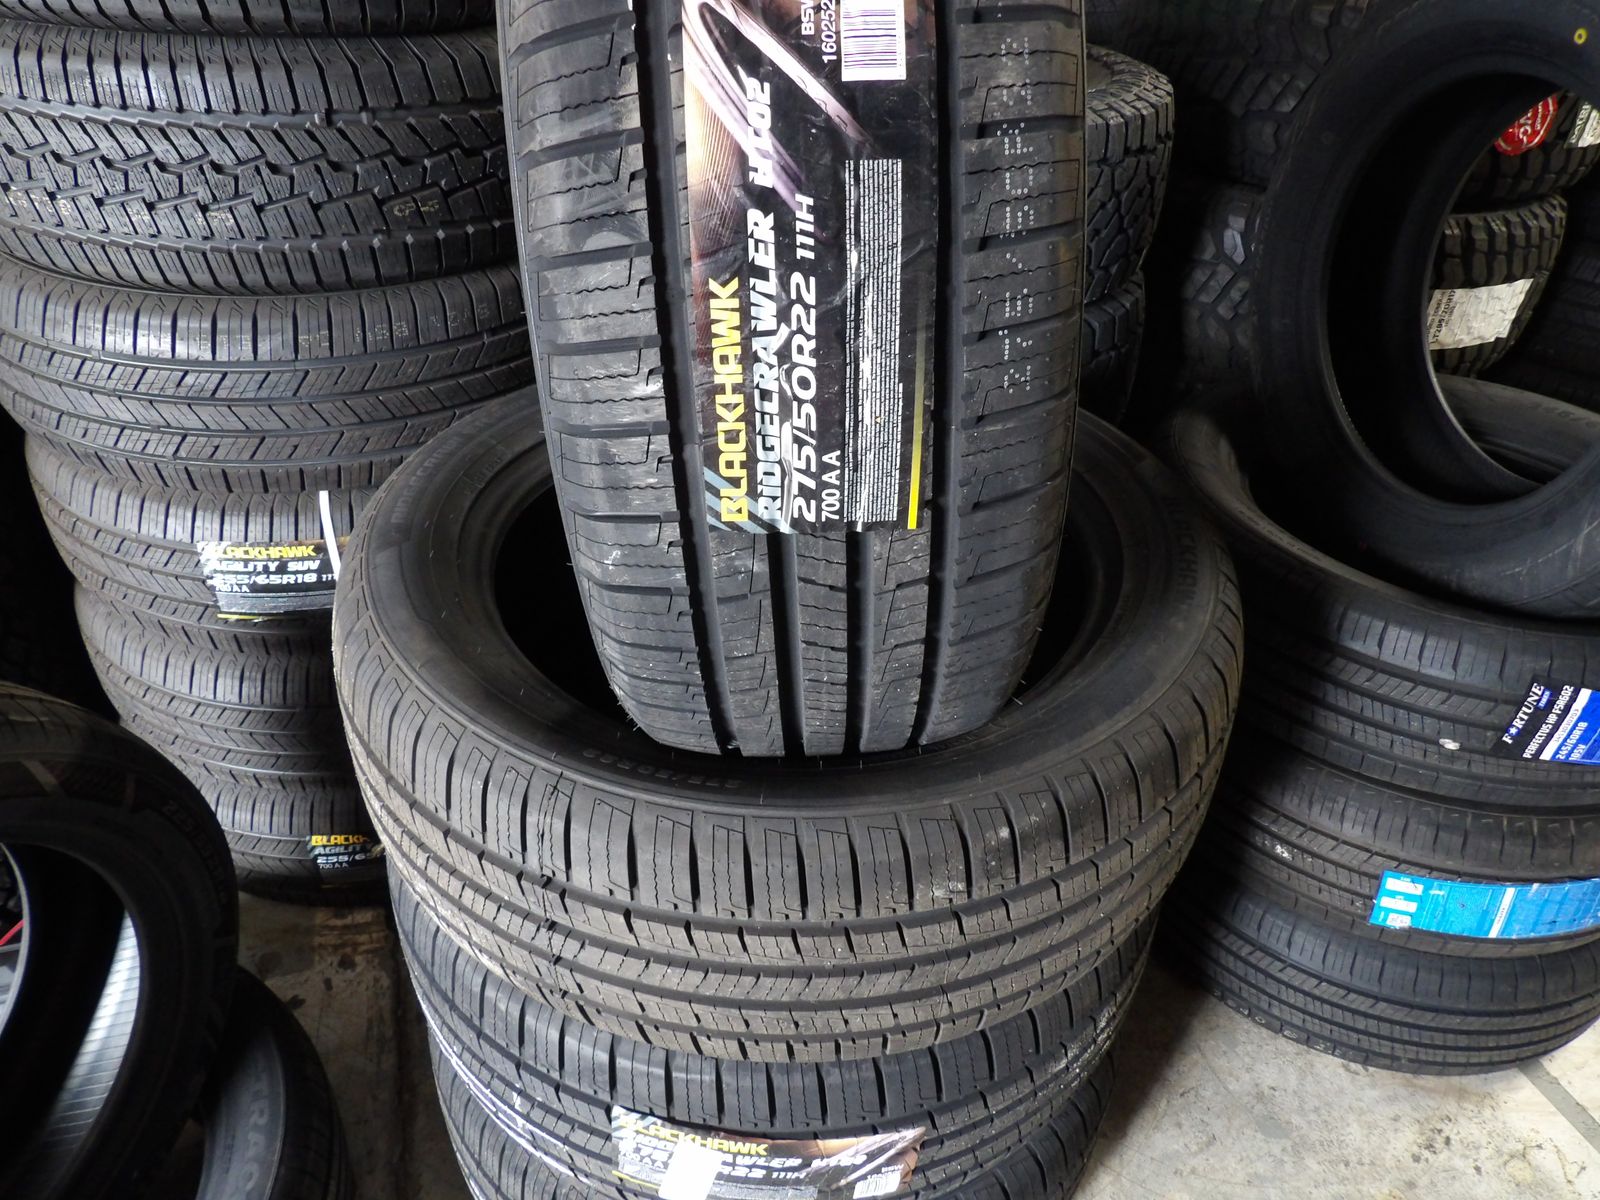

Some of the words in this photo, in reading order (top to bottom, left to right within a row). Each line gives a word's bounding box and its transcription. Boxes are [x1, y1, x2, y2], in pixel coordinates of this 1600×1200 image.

[746, 74, 773, 189] HT02
[795, 193, 816, 260] 111H
[747, 208, 780, 521] RIDGECRAWLER
[709, 277, 749, 522] BLACKHAWK
[790, 271, 817, 522] 275/50R22
[821, 469, 840, 486] A
[822, 450, 840, 467] A
[821, 489, 839, 522] 700
[212, 545, 316, 559] LACKHAWK
[287, 560, 321, 572] SUV
[1522, 723, 1554, 759] PERFECTUS
[1545, 713, 1559, 725] HP
[1552, 684, 1575, 714] FSR602
[1555, 721, 1589, 760] 245/60R18
[1568, 743, 1588, 761] 105V
